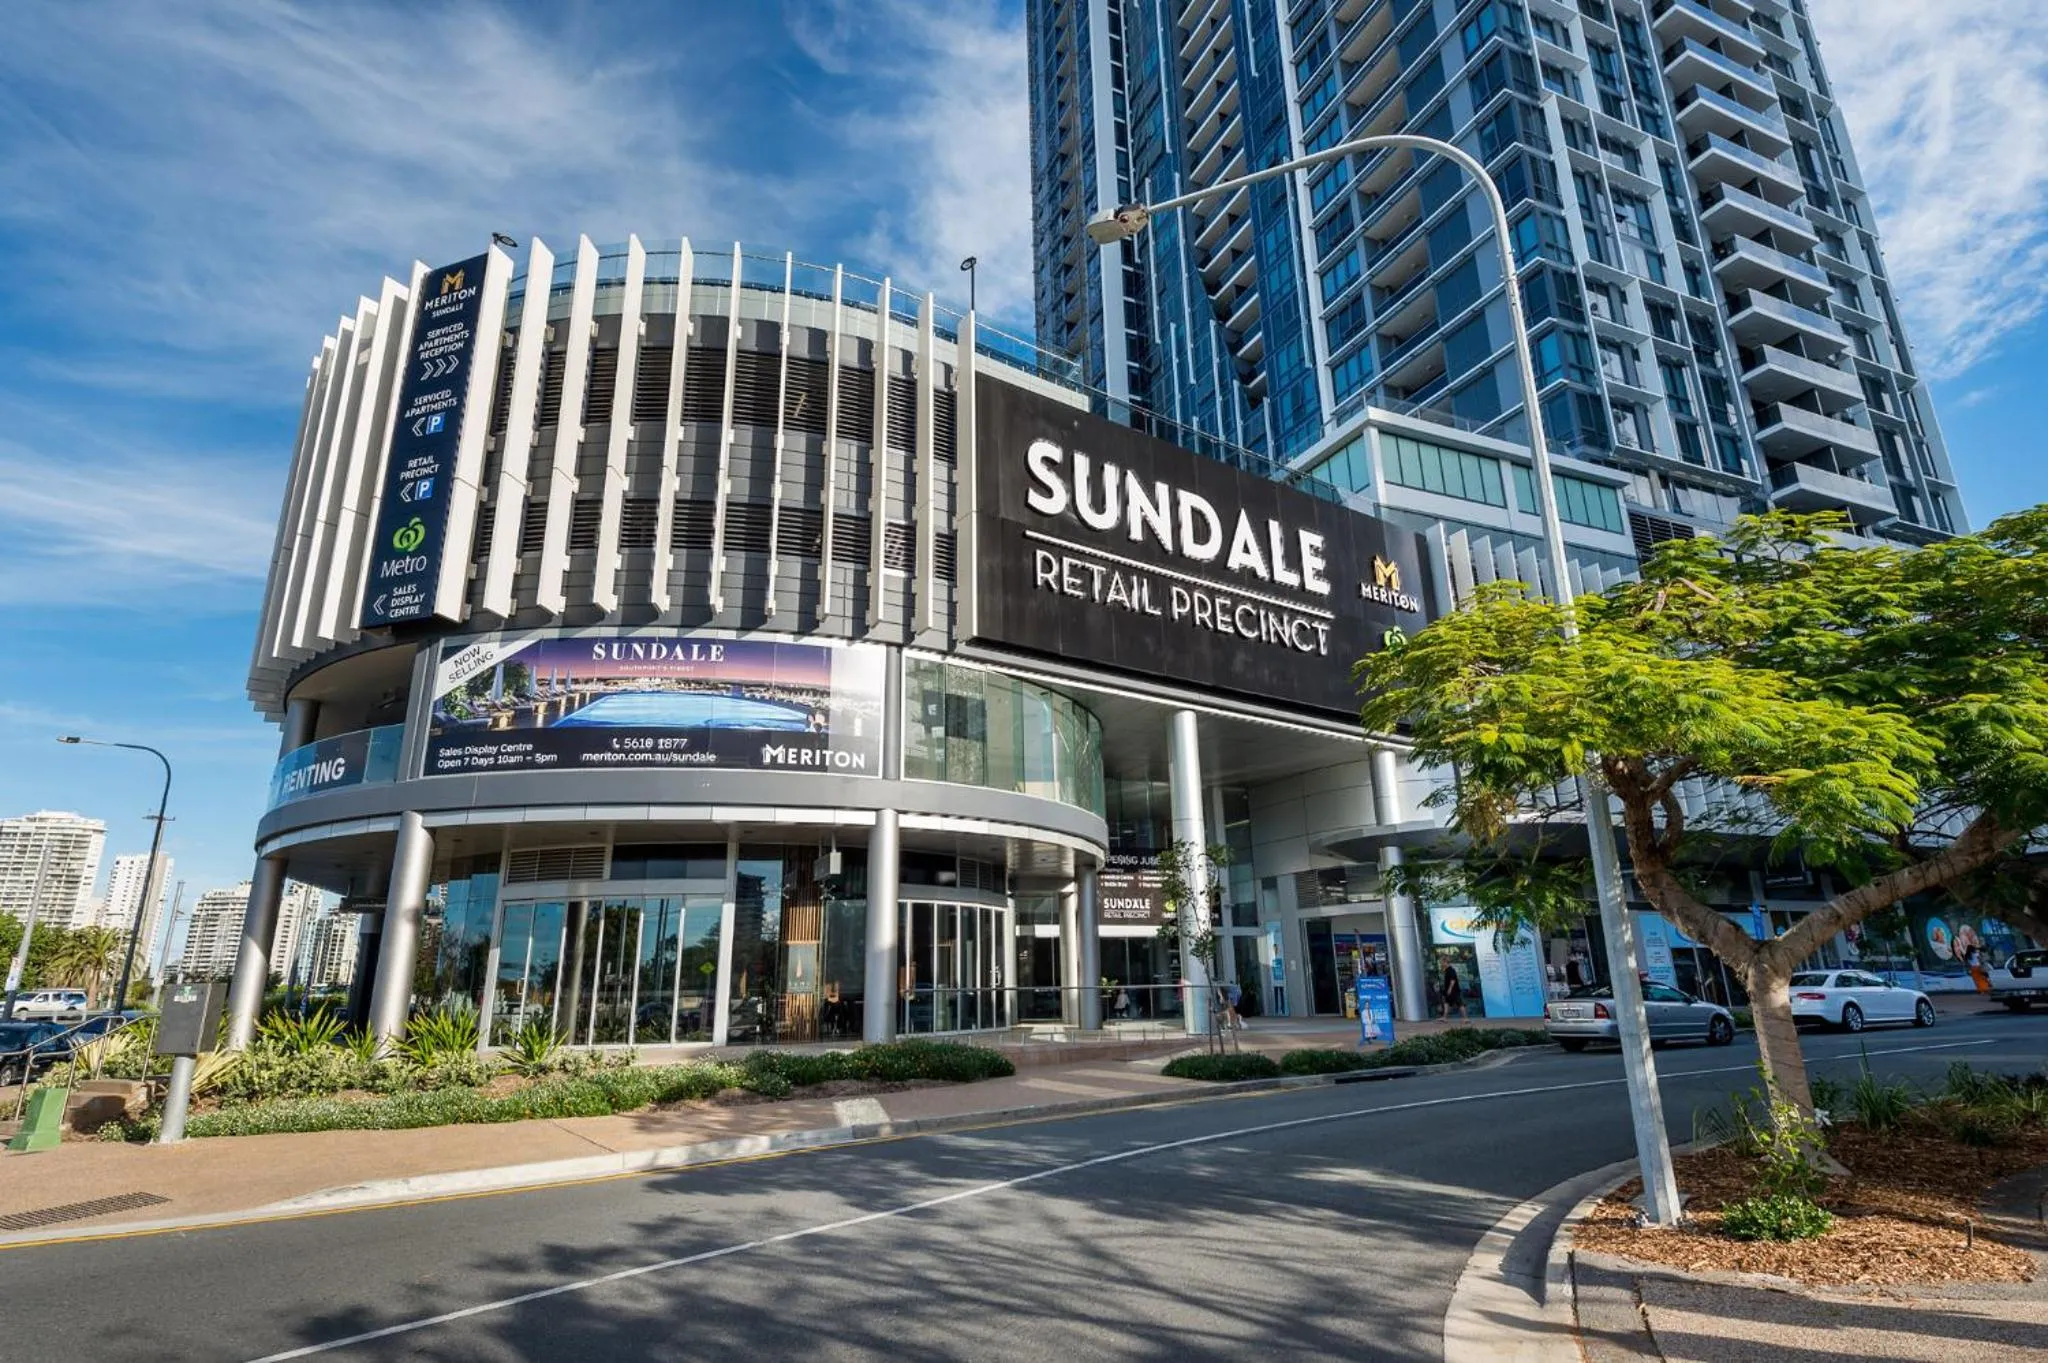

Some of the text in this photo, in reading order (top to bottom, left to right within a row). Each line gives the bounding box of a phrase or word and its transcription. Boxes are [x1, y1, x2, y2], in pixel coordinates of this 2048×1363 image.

[424, 286, 477, 311] MERITON
[418, 329, 470, 350] APARTMENTS
[426, 321, 464, 340] SERVICED
[419, 341, 464, 360] RECEPTION
[413, 388, 452, 406] SERVICED
[404, 397, 457, 418] APARTMENTS
[400, 463, 441, 480] PRECINCT
[407, 455, 435, 469] RETAIL
[1026, 437, 1332, 596] SUNDALE
[380, 555, 427, 579] Metro
[391, 592, 426, 607] DISPLAY
[392, 583, 417, 597] SALES
[1360, 582, 1420, 613] MERITON
[389, 604, 420, 618] CENTRE
[1034, 548, 1331, 658] RETAIL PRECINCT
[453, 645, 482, 668] NOW
[592, 642, 725, 662] SUNDALE
[448, 650, 495, 684] SELLING
[439, 743, 534, 758] Sales Display Centre
[657, 738, 688, 750] 1877
[437, 759, 461, 769] Open
[463, 757, 470, 766] 7
[471, 756, 495, 767] Days
[496, 754, 523, 764] 10am
[534, 753, 558, 764] 5pm
[581, 751, 717, 763] meriton.com.au/sundale
[762, 743, 866, 769] MERITON
[1103, 898, 1151, 909] SUNDALE
